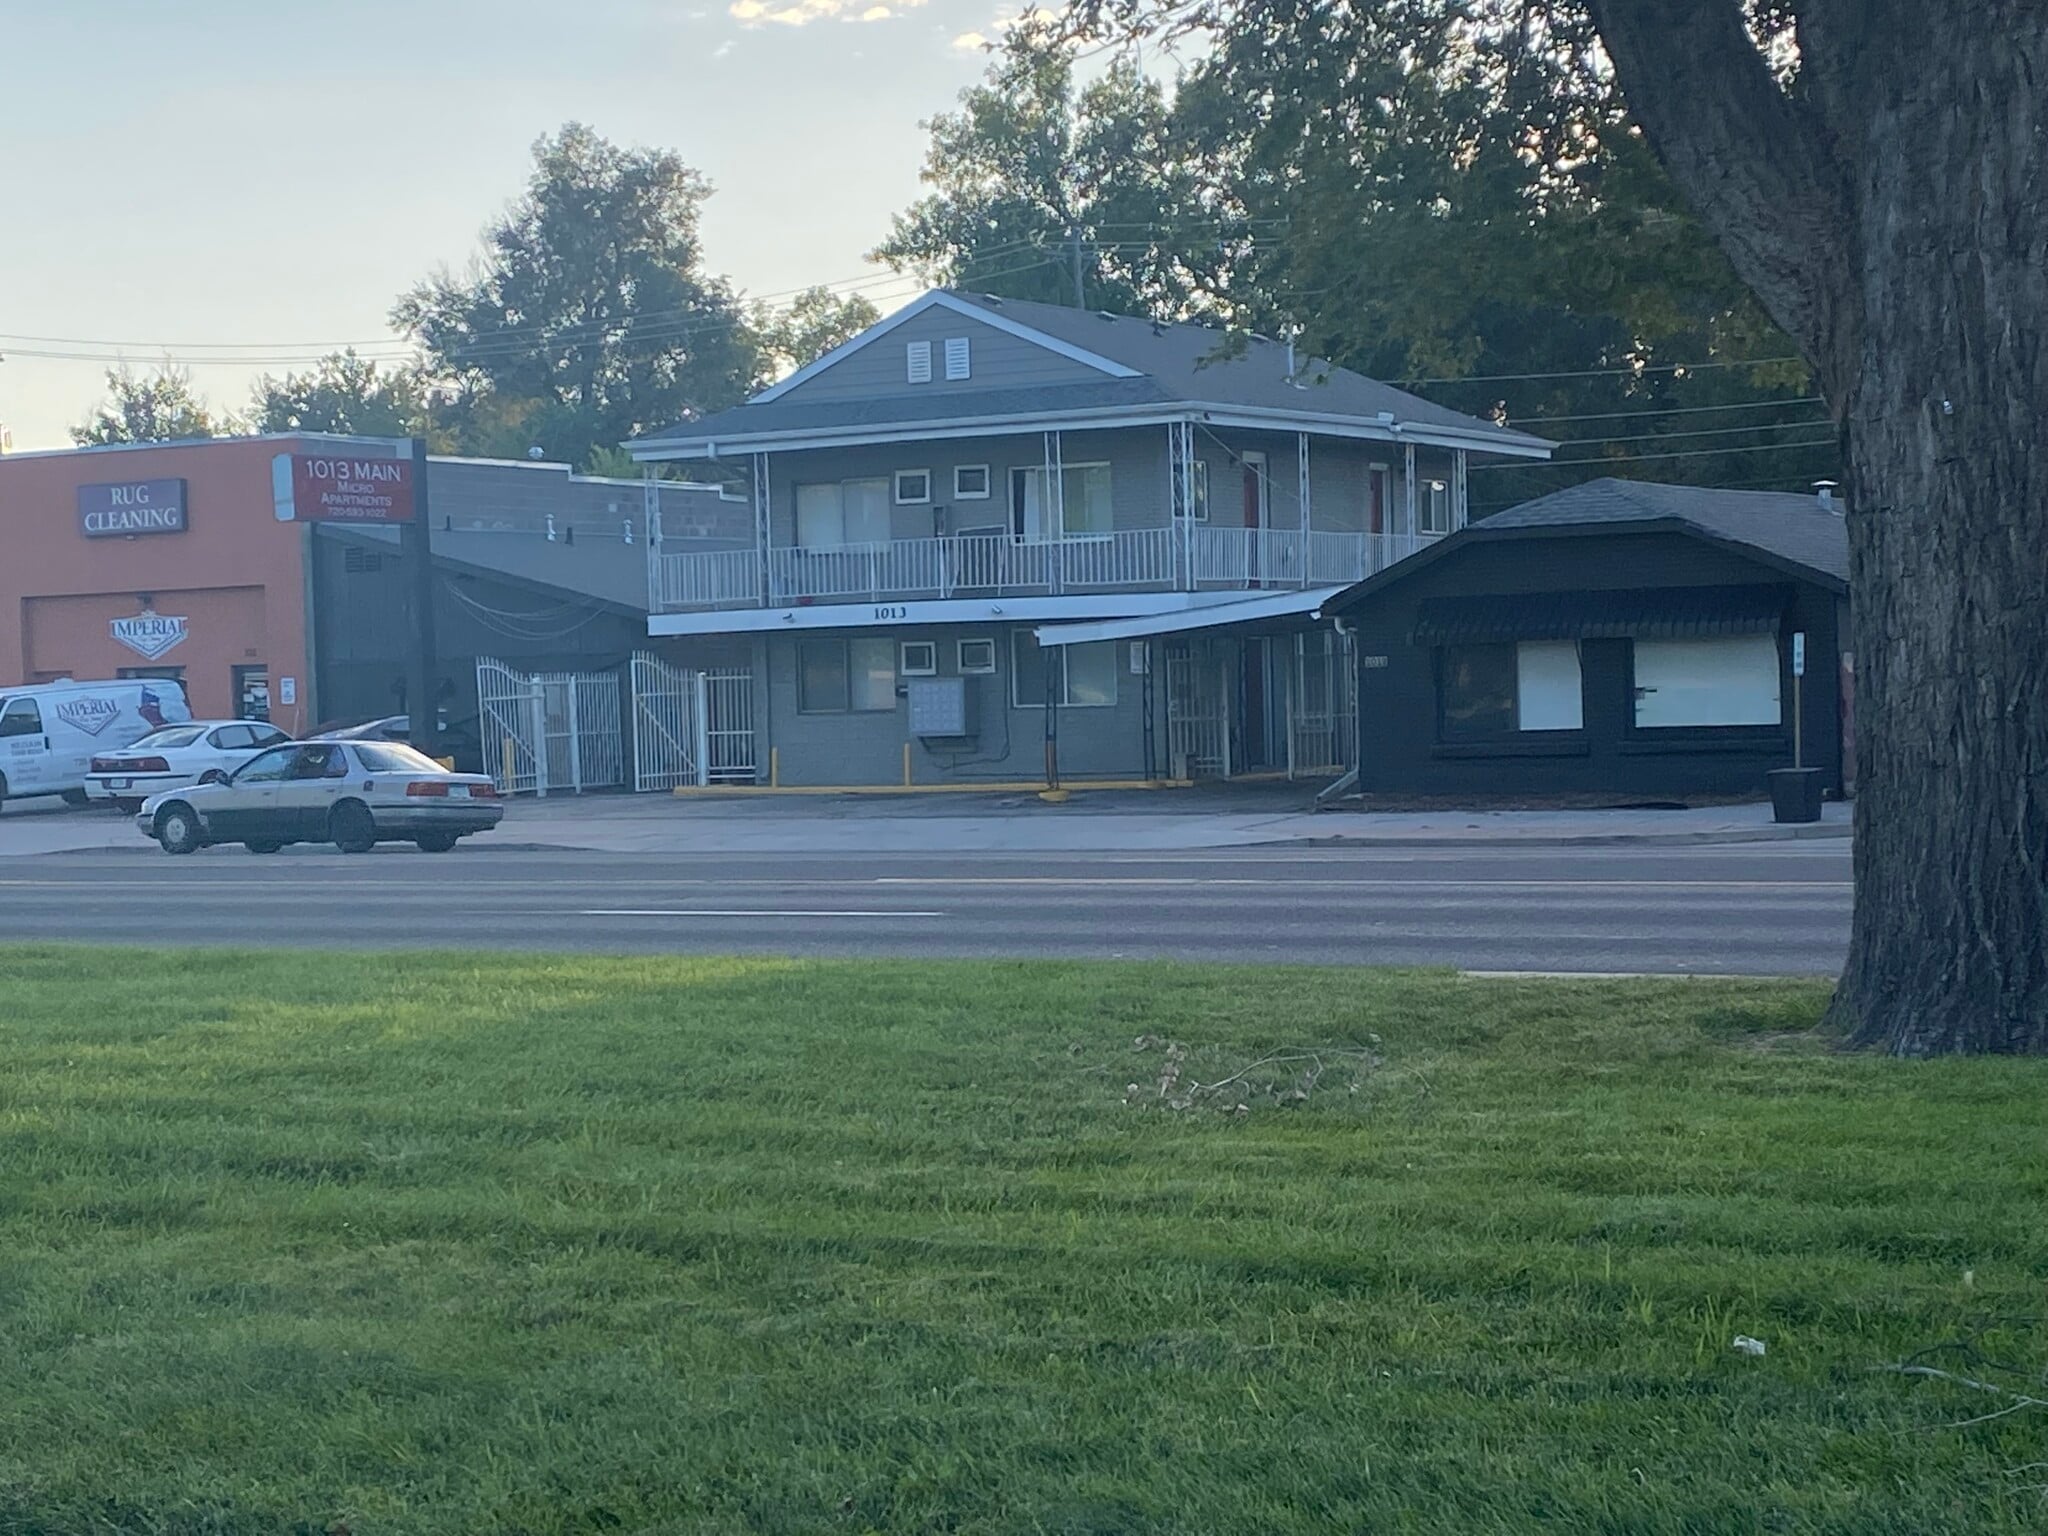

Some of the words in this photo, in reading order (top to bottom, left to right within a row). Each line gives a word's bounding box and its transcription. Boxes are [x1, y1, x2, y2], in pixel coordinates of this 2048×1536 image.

[306, 459, 349, 480] 1013
[354, 461, 401, 482] MAIN
[111, 485, 149, 505] RUG
[84, 507, 177, 531] CLEANING
[874, 606, 907, 620] 1013
[111, 619, 187, 637] IMPERIAL
